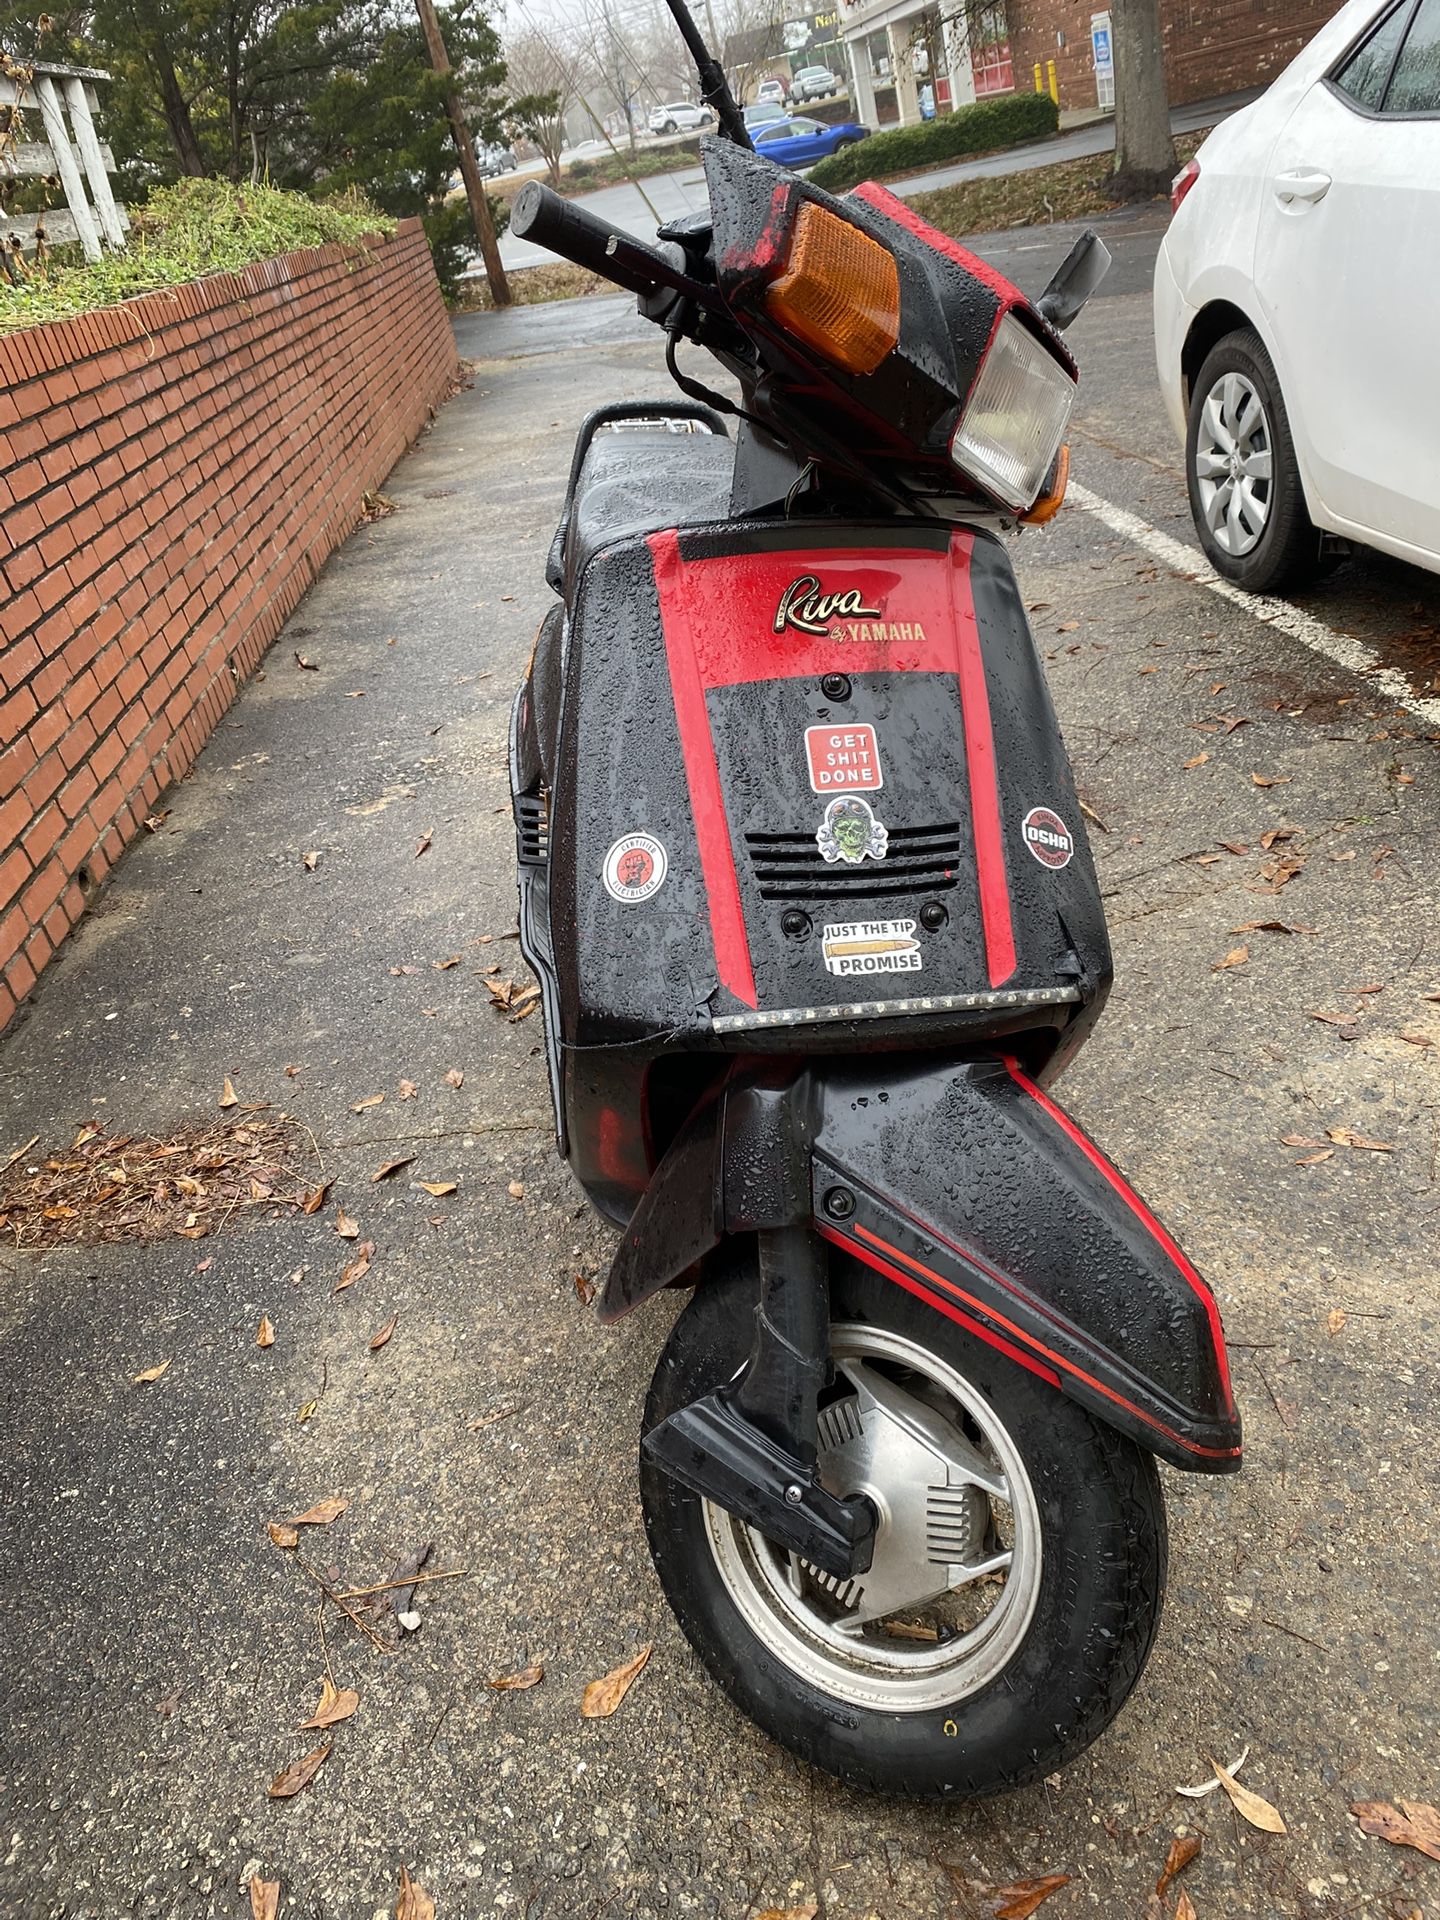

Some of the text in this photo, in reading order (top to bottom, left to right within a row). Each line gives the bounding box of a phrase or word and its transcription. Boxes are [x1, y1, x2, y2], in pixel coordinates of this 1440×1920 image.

[773, 573, 882, 635] Riva
[848, 623, 926, 642] YAMAHA
[829, 734, 868, 748] GET
[826, 751, 870, 766] SHIT
[819, 768, 873, 784] DONE
[620, 840, 657, 854] CERTIFIED
[1027, 826, 1069, 851] OSHA
[825, 921, 913, 940] JUST THE TIP
[828, 954, 919, 973] I PROMISE
